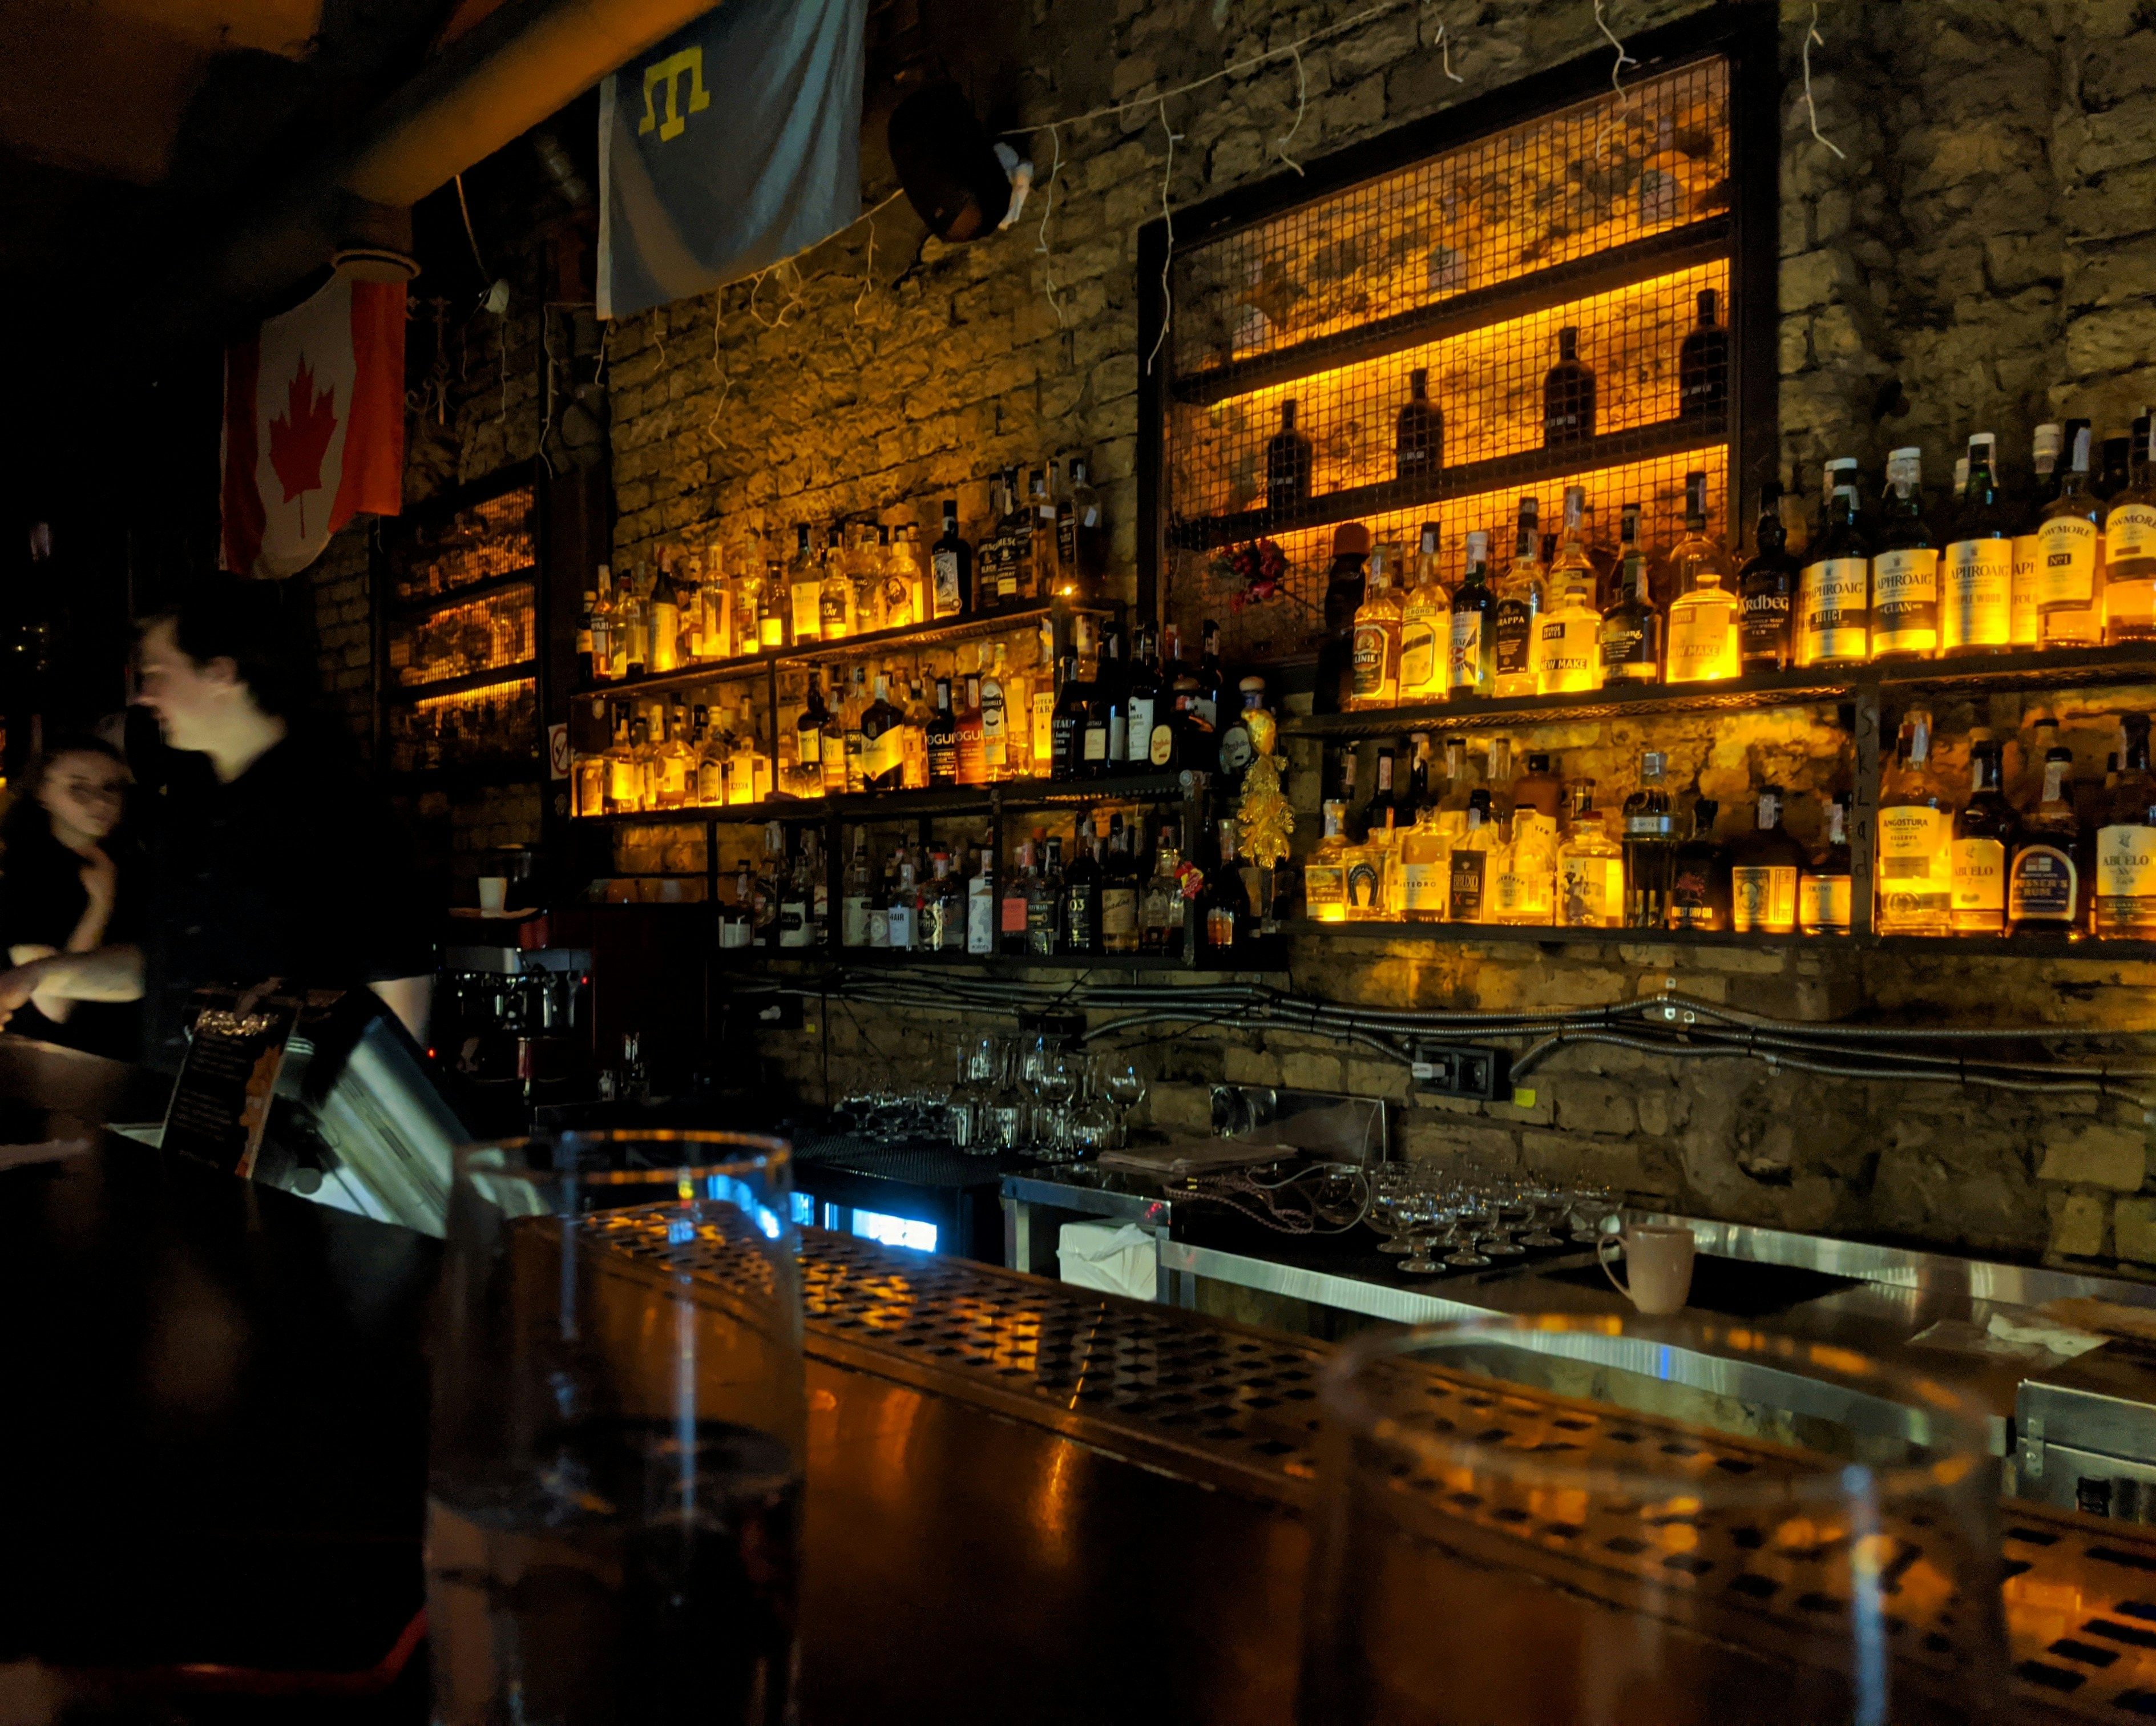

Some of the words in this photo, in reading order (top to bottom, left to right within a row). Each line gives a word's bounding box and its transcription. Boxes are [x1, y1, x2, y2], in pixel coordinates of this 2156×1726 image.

[1878, 573, 1933, 590] APHROAIG
[1811, 582, 1864, 598] APHROAIG
[2013, 594, 2037, 604] FOU
[1738, 594, 1789, 616] Ardbeg
[1815, 610, 1842, 623] SELECT
[1688, 645, 1718, 656] MAKE
[1540, 659, 1556, 670] NEW
[1558, 659, 1585, 669] MAKE
[1883, 818, 1928, 828] ANGOSTURA
[1955, 866, 1993, 876] ABUELO
